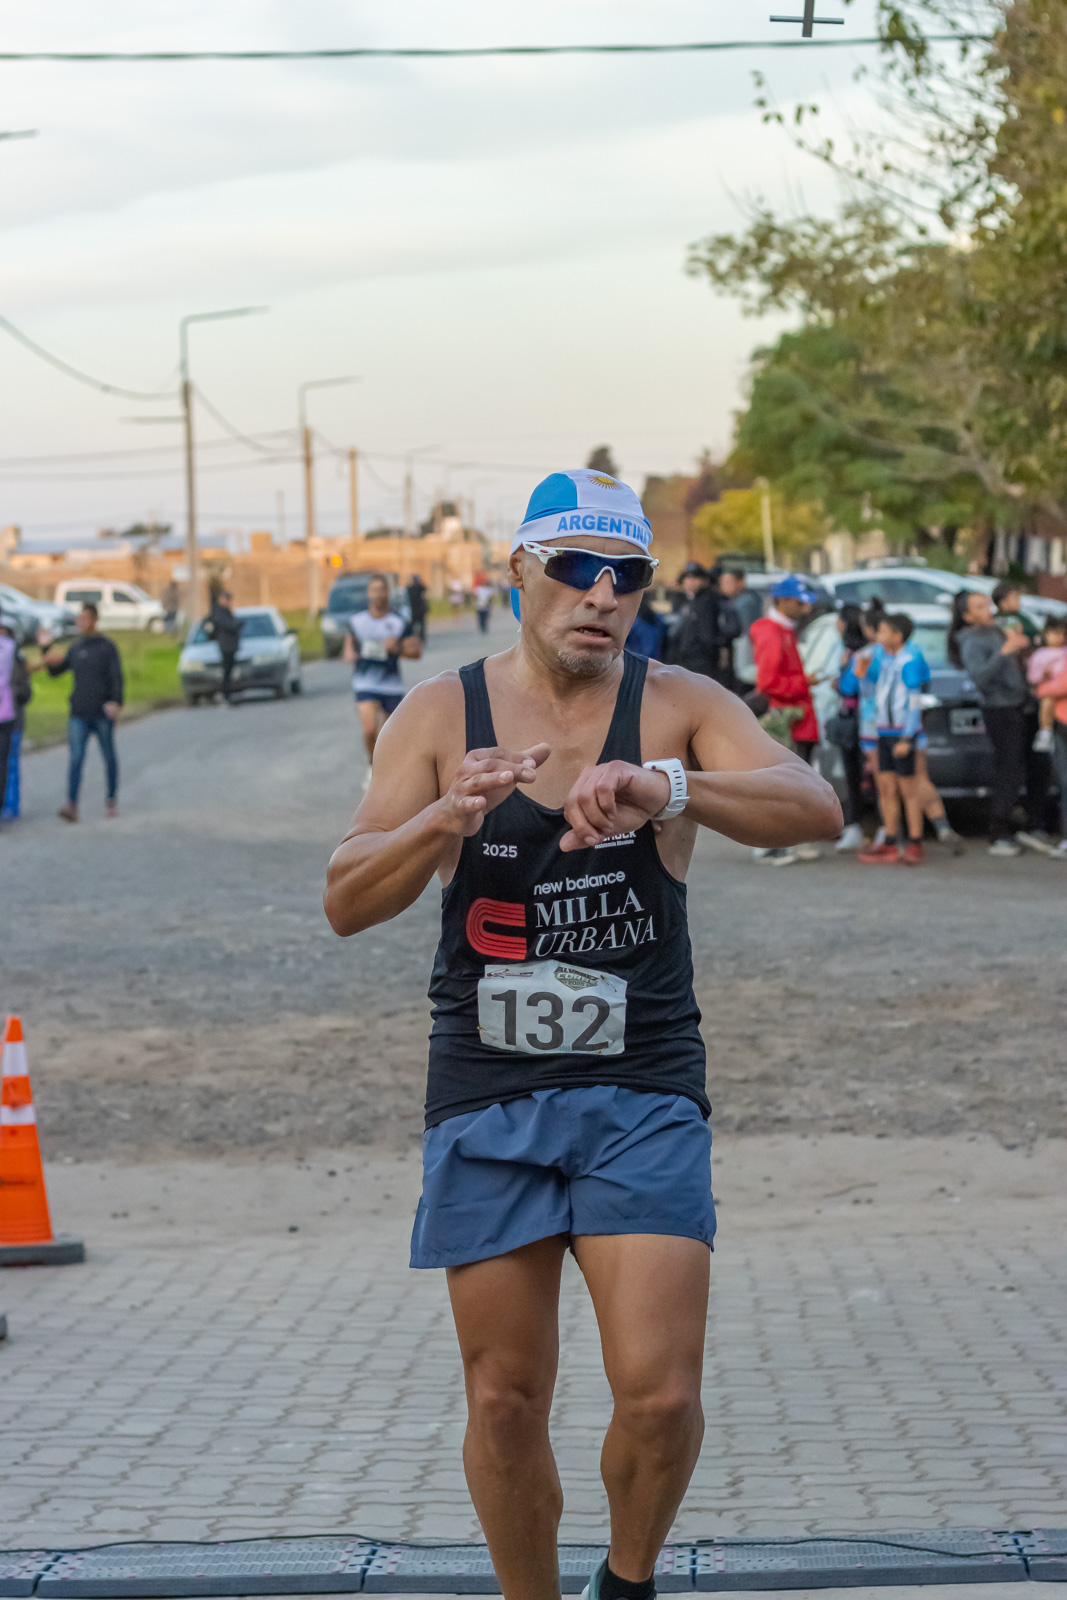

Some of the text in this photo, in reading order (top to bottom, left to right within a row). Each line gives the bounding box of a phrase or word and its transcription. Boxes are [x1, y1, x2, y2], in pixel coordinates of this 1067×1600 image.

[482, 842, 518, 859] 2025
[533, 870, 626, 896] new balance
[533, 887, 645, 928] MILLA
[535, 914, 657, 957] URBANA
[491, 989, 611, 1052] 132
